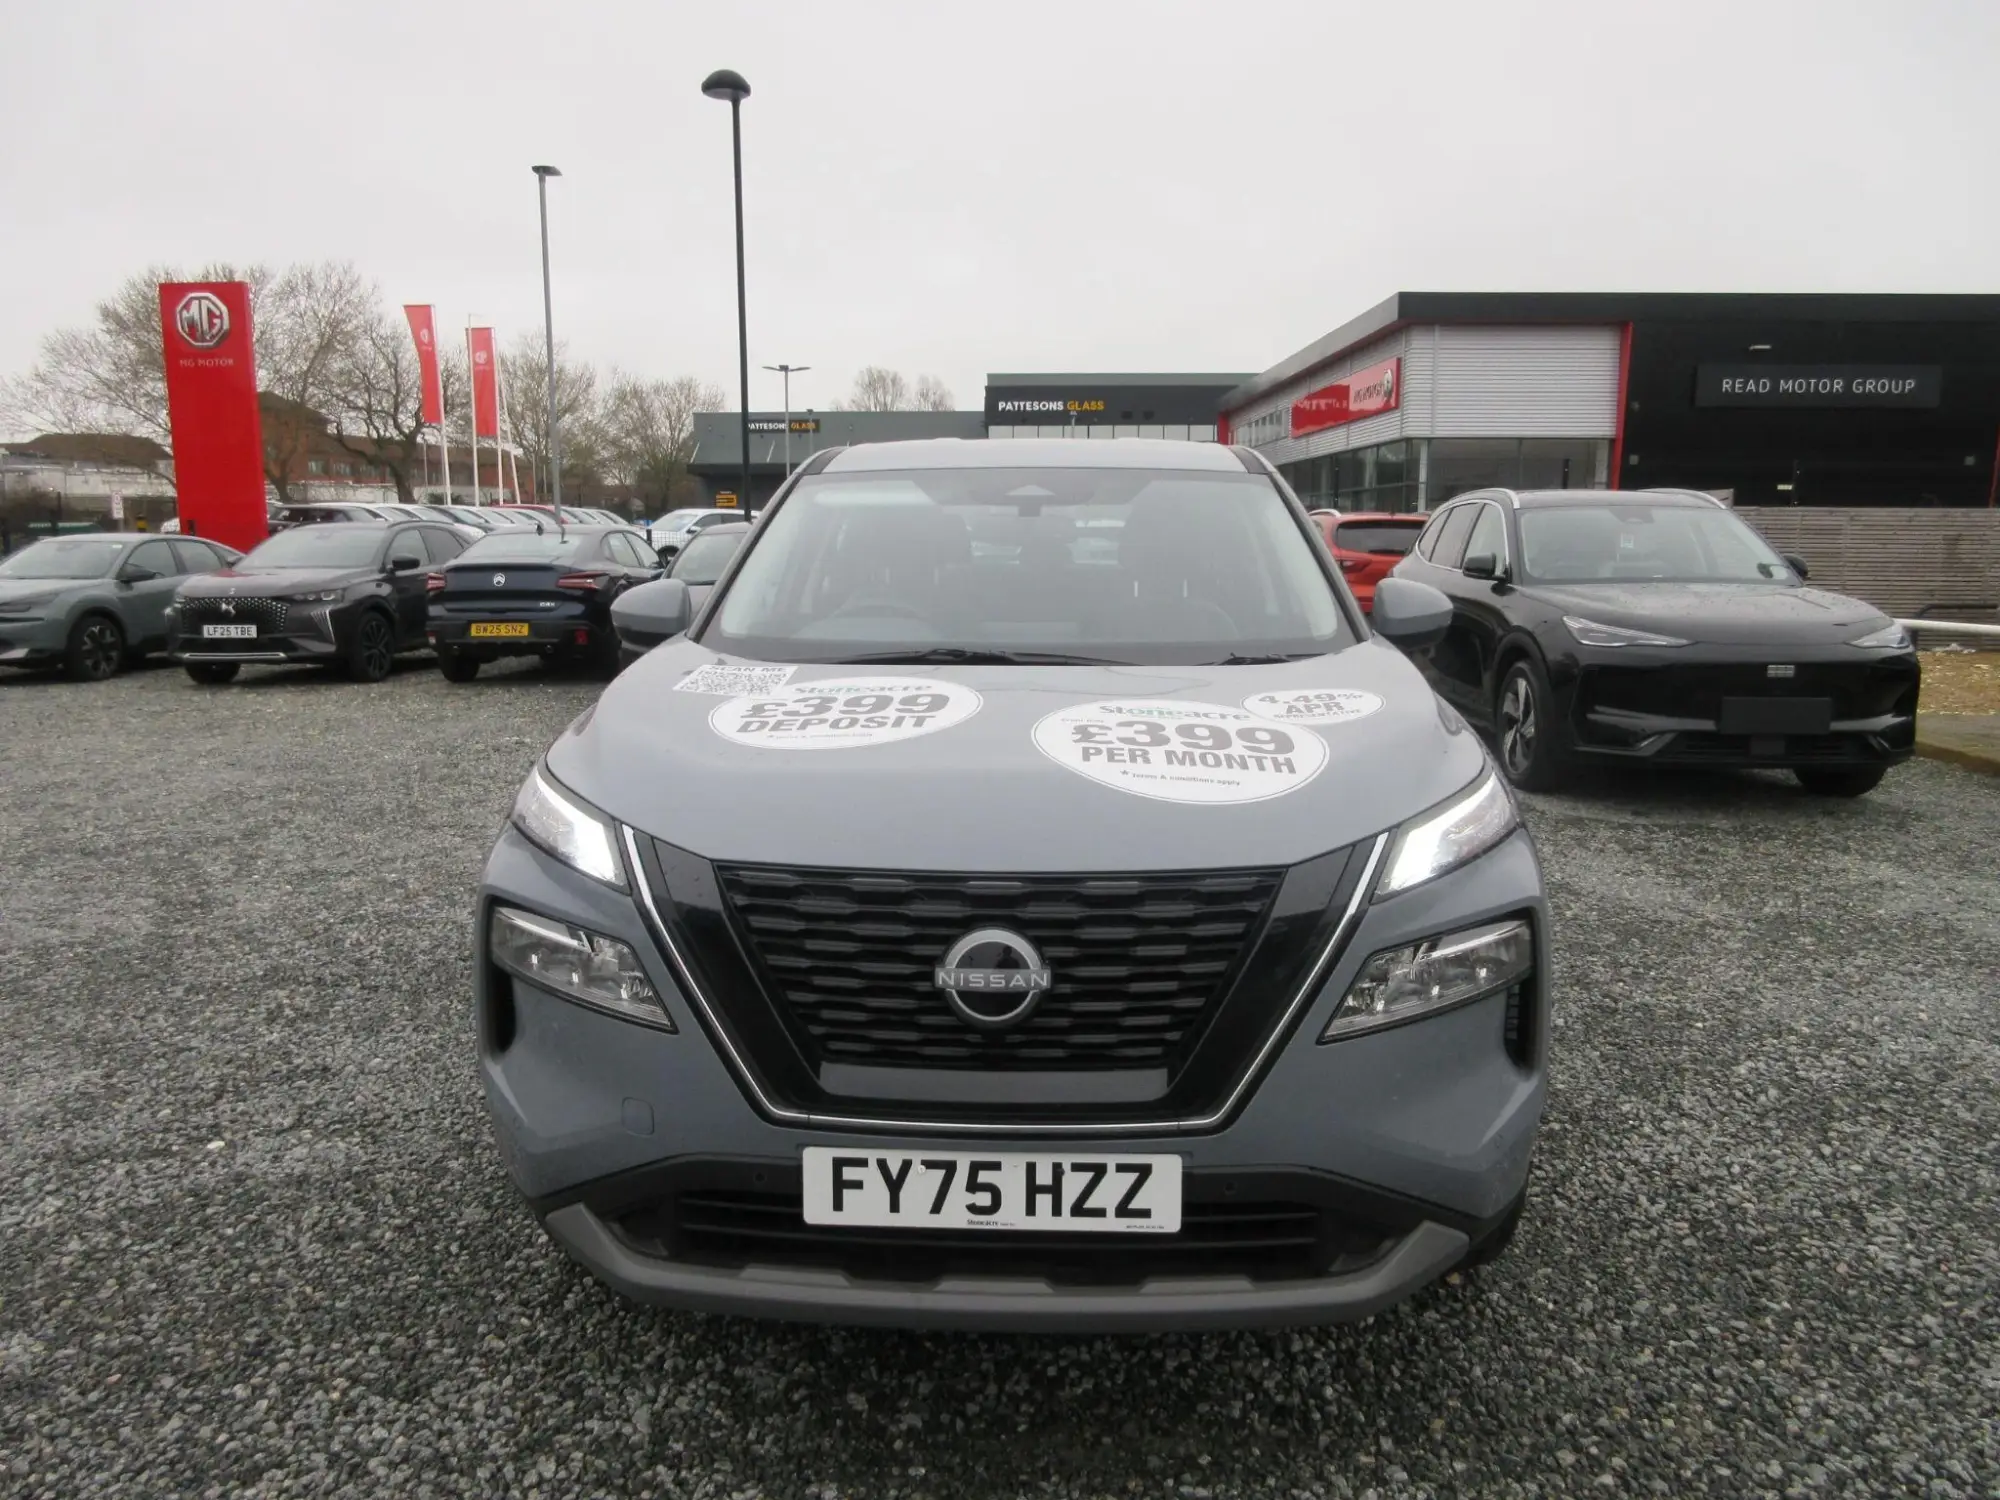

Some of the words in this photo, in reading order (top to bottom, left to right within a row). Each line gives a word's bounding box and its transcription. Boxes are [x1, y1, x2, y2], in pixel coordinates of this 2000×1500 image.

[180, 298, 223, 341] MG
[180, 359, 195, 367] MG
[198, 358, 234, 367] MOTOR
[1721, 378, 1771, 393] READ
[1779, 378, 1844, 394] MOTOR
[1852, 378, 1916, 394] GROUP
[998, 400, 1065, 411] PATTESONS
[1066, 400, 1105, 411] GLASS
[748, 422, 789, 430] ATTESON
[207, 626, 232, 636] LF25
[505, 624, 525, 634] SNZ
[707, 665, 756, 673] SCAN
[741, 693, 950, 718] £399
[1286, 701, 1345, 714] APR
[736, 714, 938, 733] DEPOSIT
[1071, 720, 1295, 755] £399
[1081, 746, 1152, 765] PER
[1164, 749, 1297, 774] MONTH
[938, 971, 1048, 988] NISSAN
[831, 1156, 1003, 1216] FY75
[1024, 1161, 1153, 1219] HZZ
